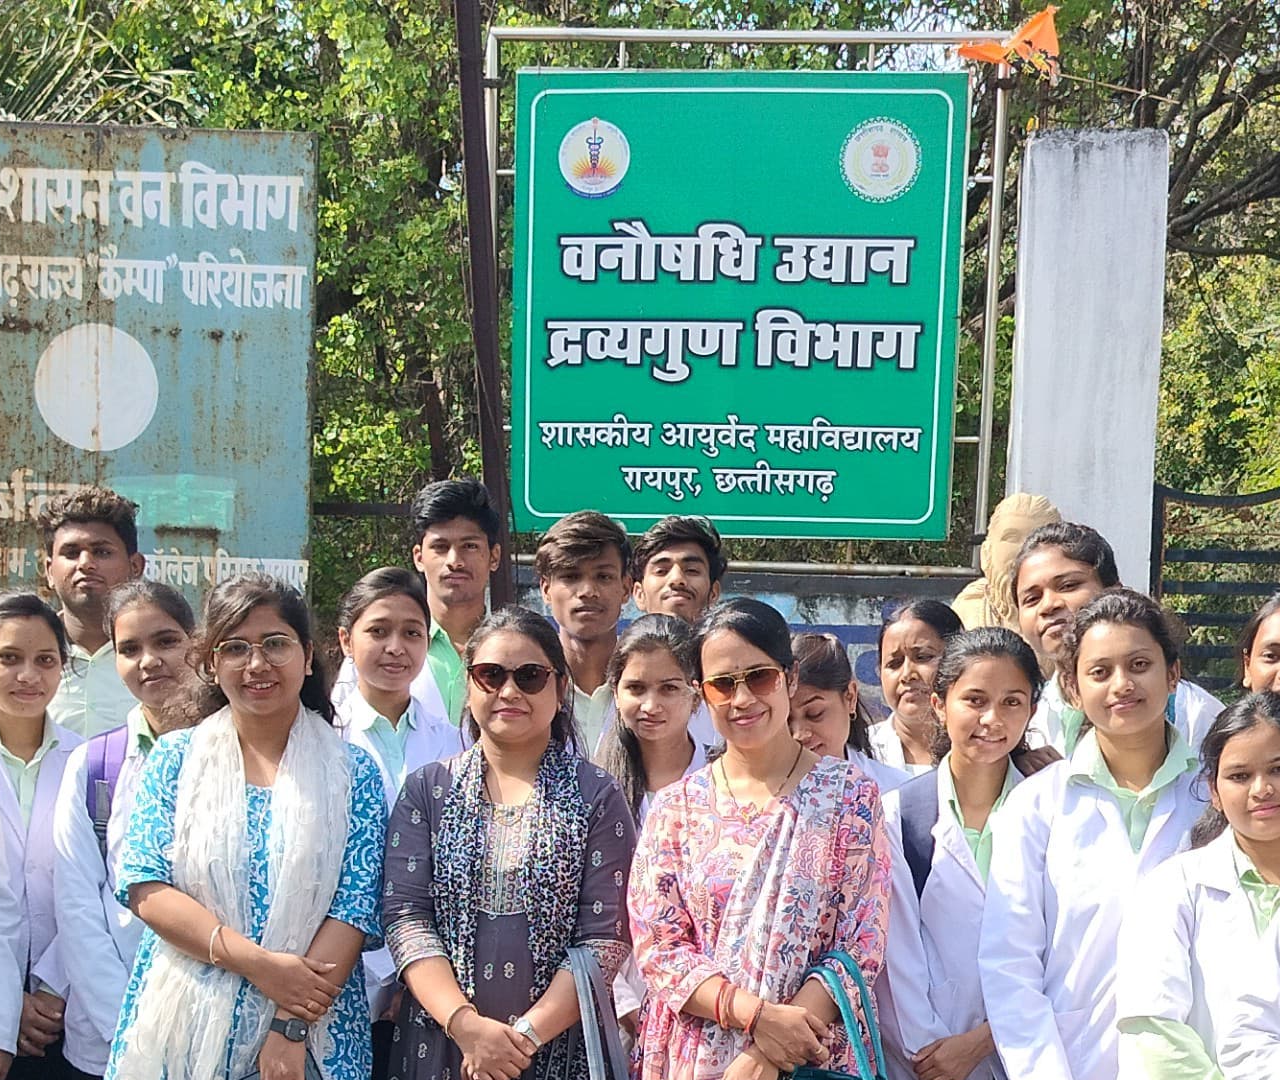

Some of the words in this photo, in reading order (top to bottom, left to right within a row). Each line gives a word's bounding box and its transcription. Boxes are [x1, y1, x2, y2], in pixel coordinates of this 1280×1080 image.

[116, 170, 176, 229] वन
[177, 161, 304, 232] विभाग
[179, 247, 307, 310] परियोजना
[559, 218, 763, 283] वनौषधि
[773, 235, 916, 285] उद्यान
[546, 319, 744, 383] द्रव्यगुण
[754, 308, 923, 370] विभाग
[538, 413, 653, 449] शासकीय
[660, 414, 758, 459] आयुर्वेद
[765, 416, 922, 453] महाविद्यालय
[620, 466, 702, 501] रायपुर,
[711, 459, 837, 504] छत्तीसगढ़
